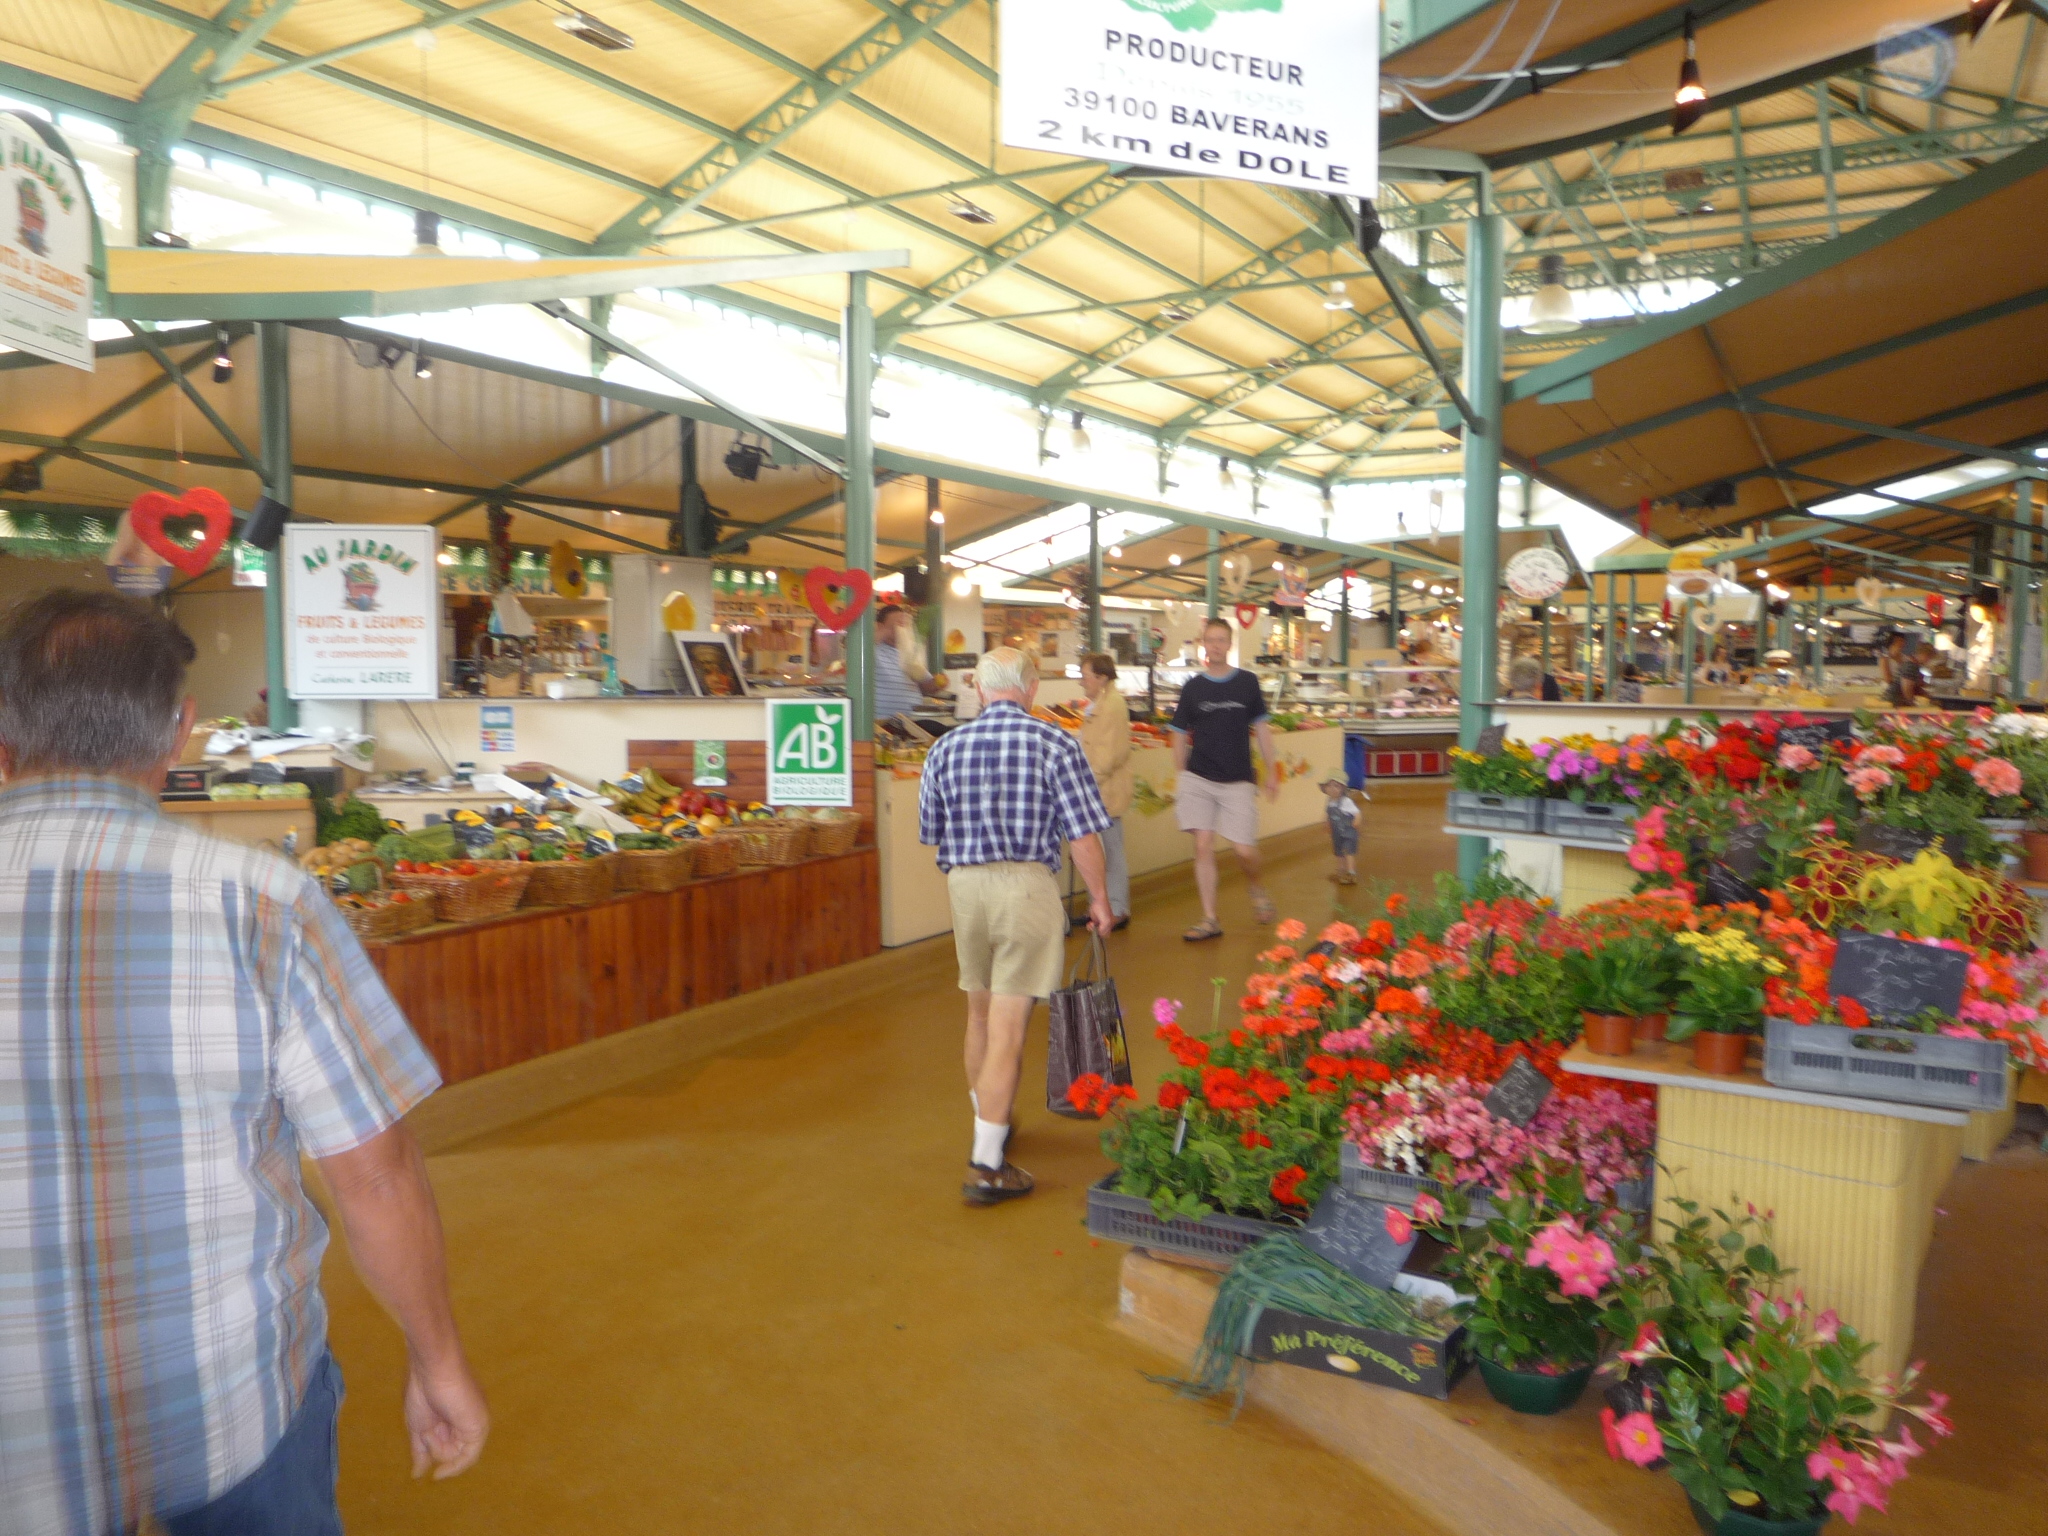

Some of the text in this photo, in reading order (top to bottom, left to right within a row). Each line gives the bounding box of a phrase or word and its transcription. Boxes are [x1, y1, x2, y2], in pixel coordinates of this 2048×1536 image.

[1105, 29, 1305, 87] PRODUCTEUR
[1063, 87, 1330, 149] 39100 BAVERANS
[1037, 119, 1351, 185] 2 km de DOLE
[302, 538, 420, 576] AU JARDIN
[297, 615, 344, 629] FRUITS
[348, 617, 359, 629] &
[775, 722, 838, 769] AB
[773, 786, 847, 796] BIOLOGIQUE
[774, 776, 847, 786] AGRICULTURE
[1269, 1331, 1302, 1354] Ma
